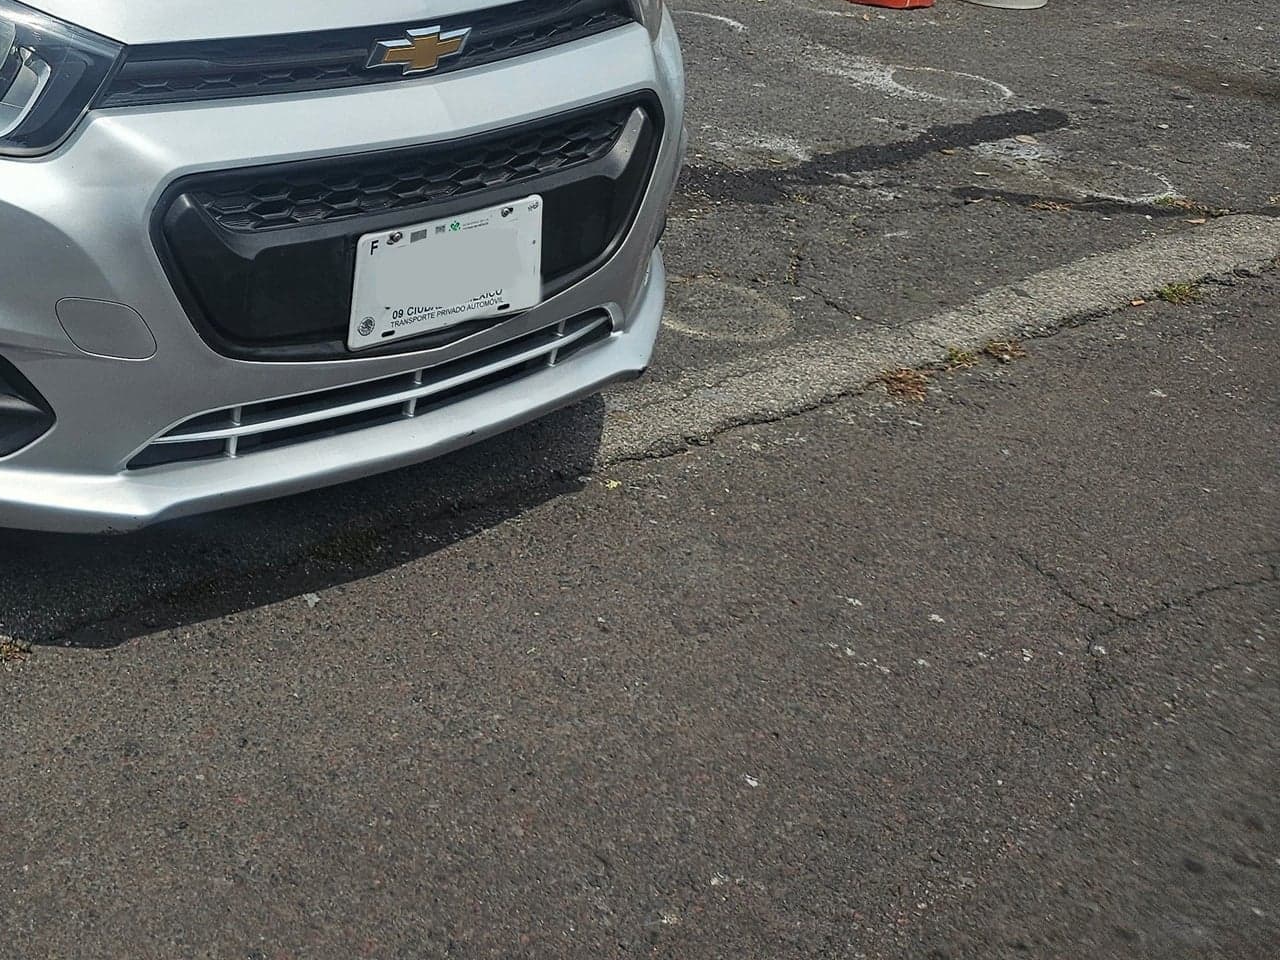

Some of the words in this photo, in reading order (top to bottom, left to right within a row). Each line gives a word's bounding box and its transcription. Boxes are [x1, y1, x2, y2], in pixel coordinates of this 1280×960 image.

[390, 311, 436, 328] TRANSPORTE
[437, 304, 466, 318] PRIVADO
[392, 308, 405, 320] 09
